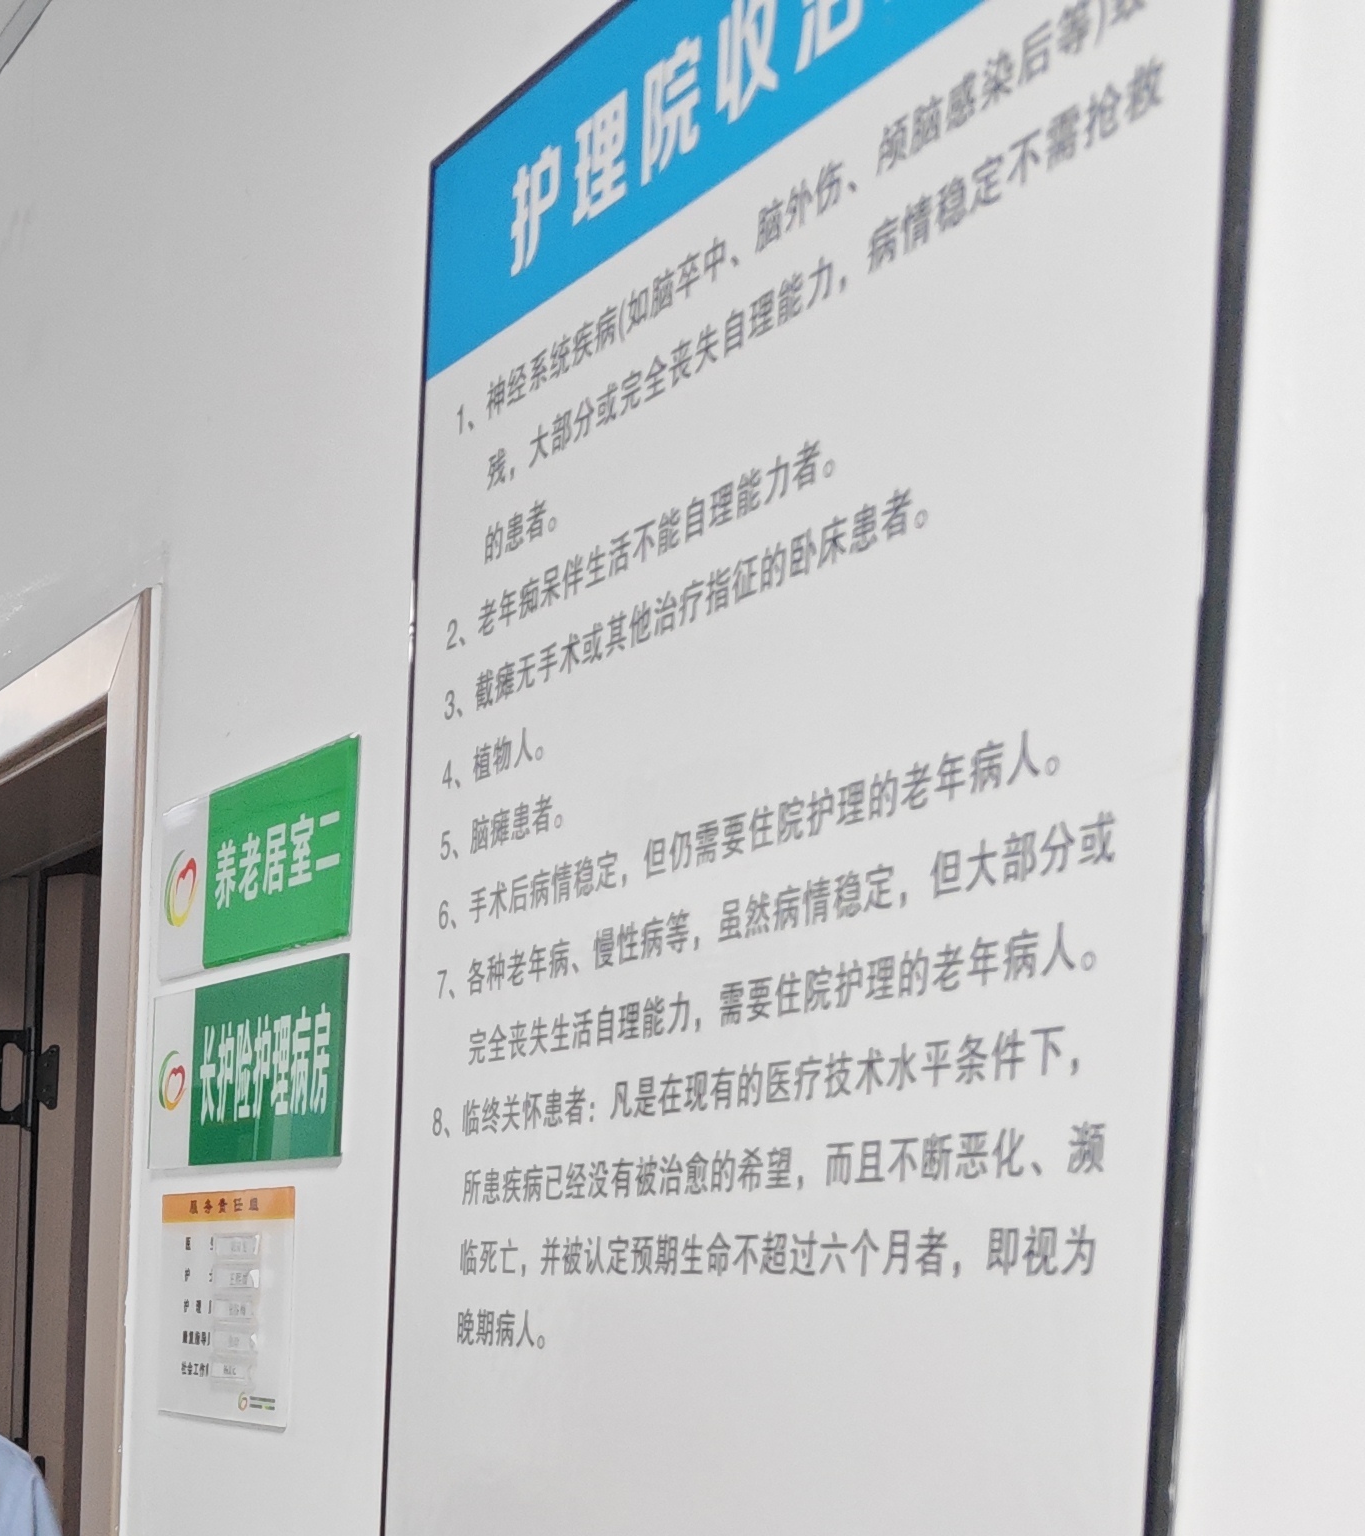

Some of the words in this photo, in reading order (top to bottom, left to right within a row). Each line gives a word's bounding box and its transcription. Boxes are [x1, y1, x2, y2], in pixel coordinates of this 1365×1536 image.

[446, 439, 836, 651] 2、老年痴呆伴生活不能自理能力者。
[483, 500, 558, 565] 的患者。
[441, 726, 545, 790] 4、植物人。
[214, 810, 341, 911] 养老居室二
[437, 728, 1061, 930] 6、手术后病情稳定，但仍需要住院护理的老年病人。
[439, 793, 564, 861] 5、脑瘫患者。
[436, 810, 1117, 1000] 7、各种老年病、慢性病等，虽然病情稳定，但大部分或
[467, 920, 1098, 1066] 完全丧失生活自理能力，需要住院护理的老年病人。
[199, 1001, 332, 1127] 长护险护理病房
[461, 1120, 1107, 1206] 所患疾病已经没有被治愈的希望，而且不断恶化、濒
[459, 1223, 1097, 1279] 临死亡，并被认定预期生命不超过六个月者，即视为
[455, 1307, 547, 1351] 晚期病人。
